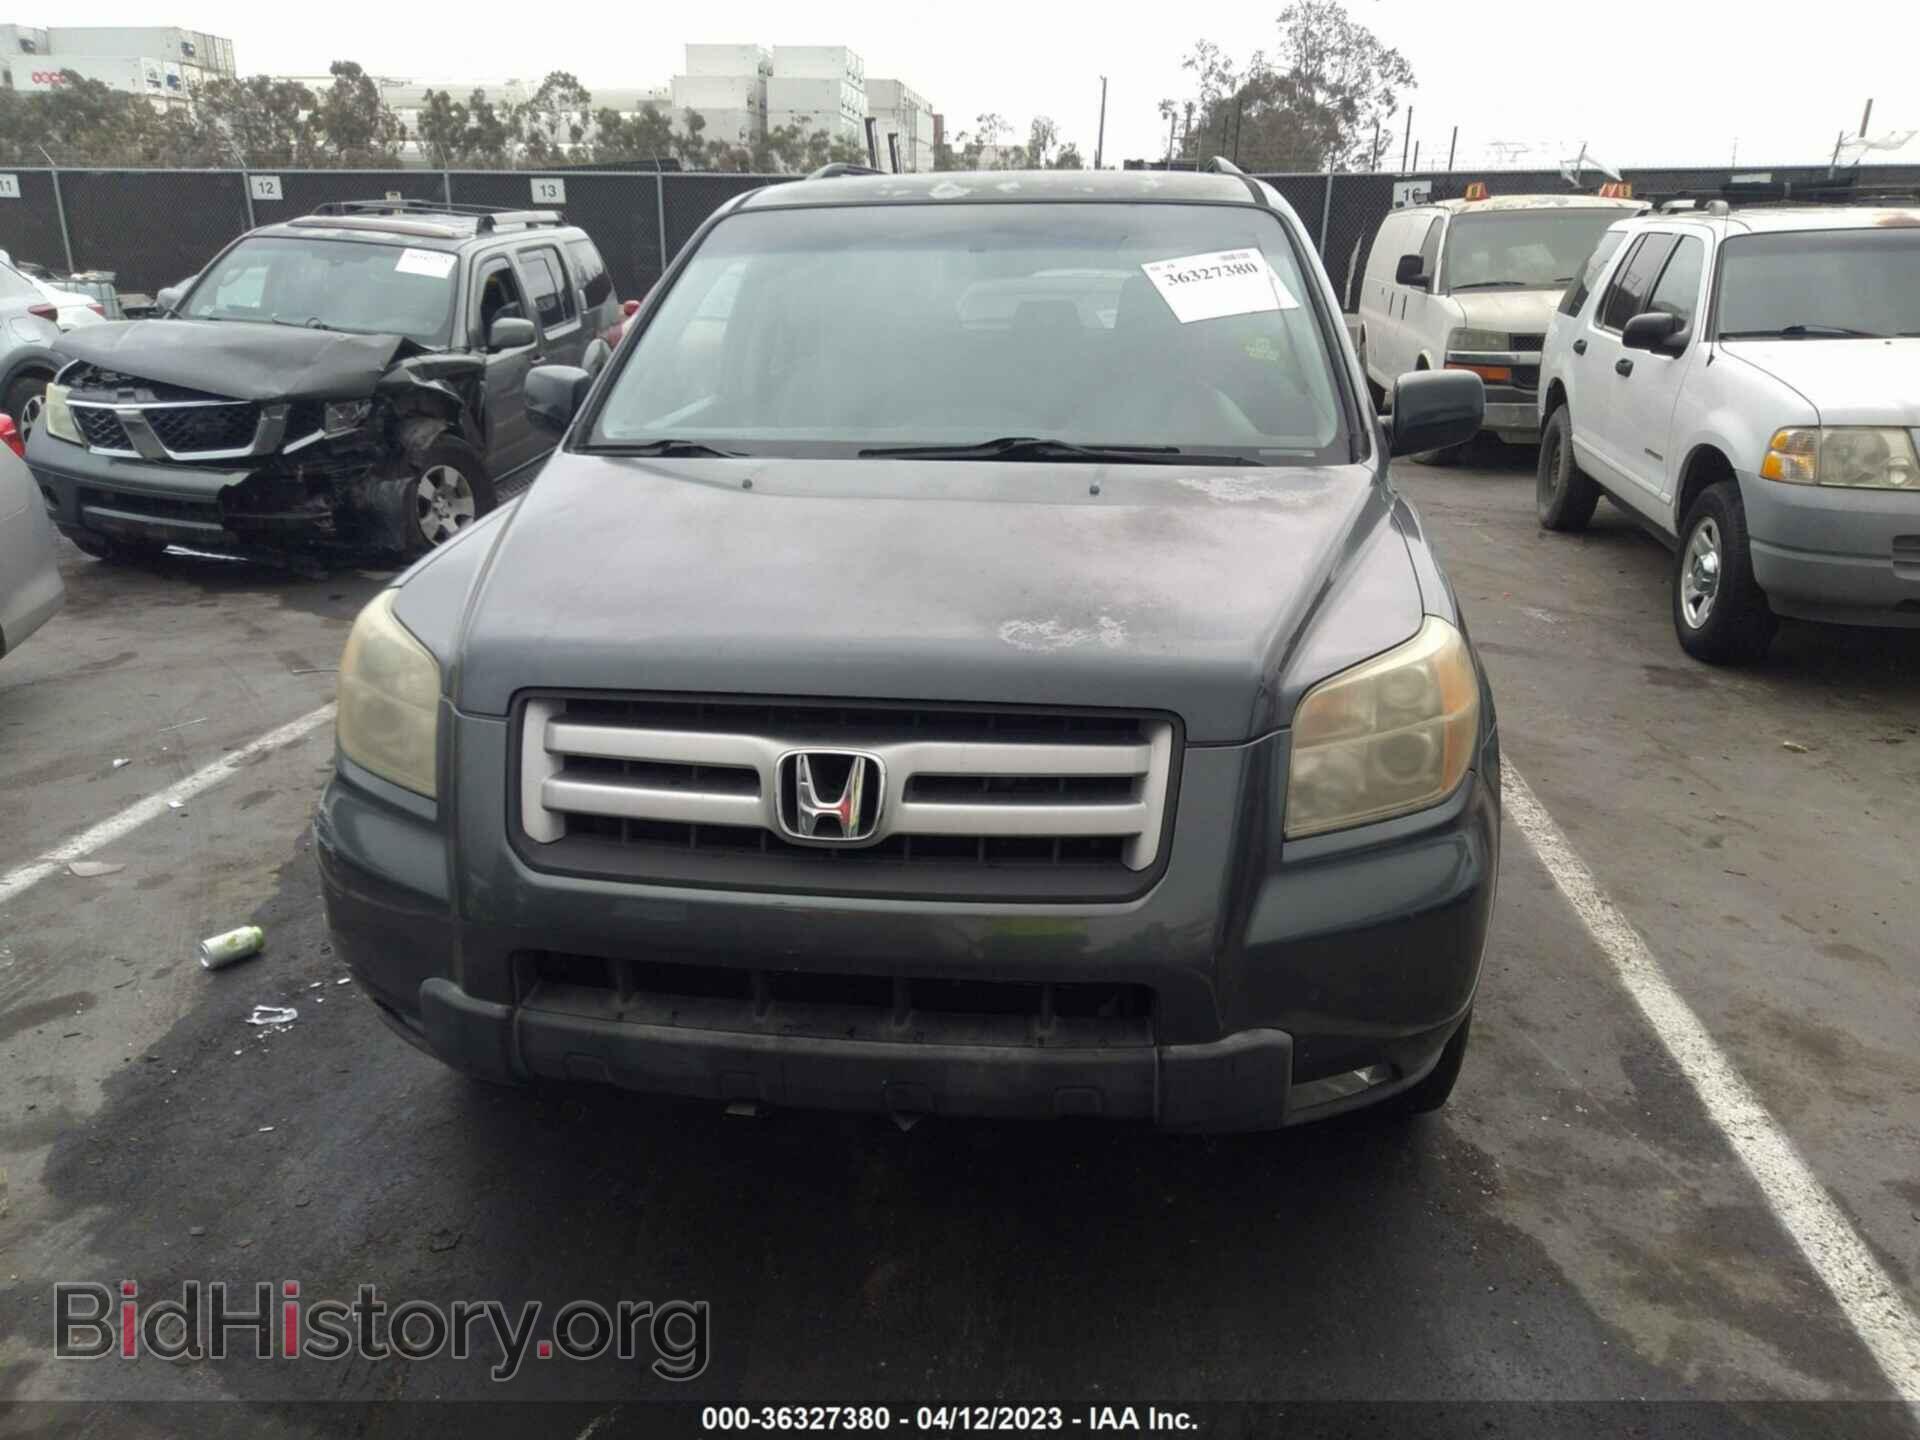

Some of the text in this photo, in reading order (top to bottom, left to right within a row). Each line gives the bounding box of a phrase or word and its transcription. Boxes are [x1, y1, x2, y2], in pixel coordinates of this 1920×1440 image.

[258, 181, 274, 194] 12
[539, 184, 557, 198] 13
[1164, 261, 1259, 287] 36327380
